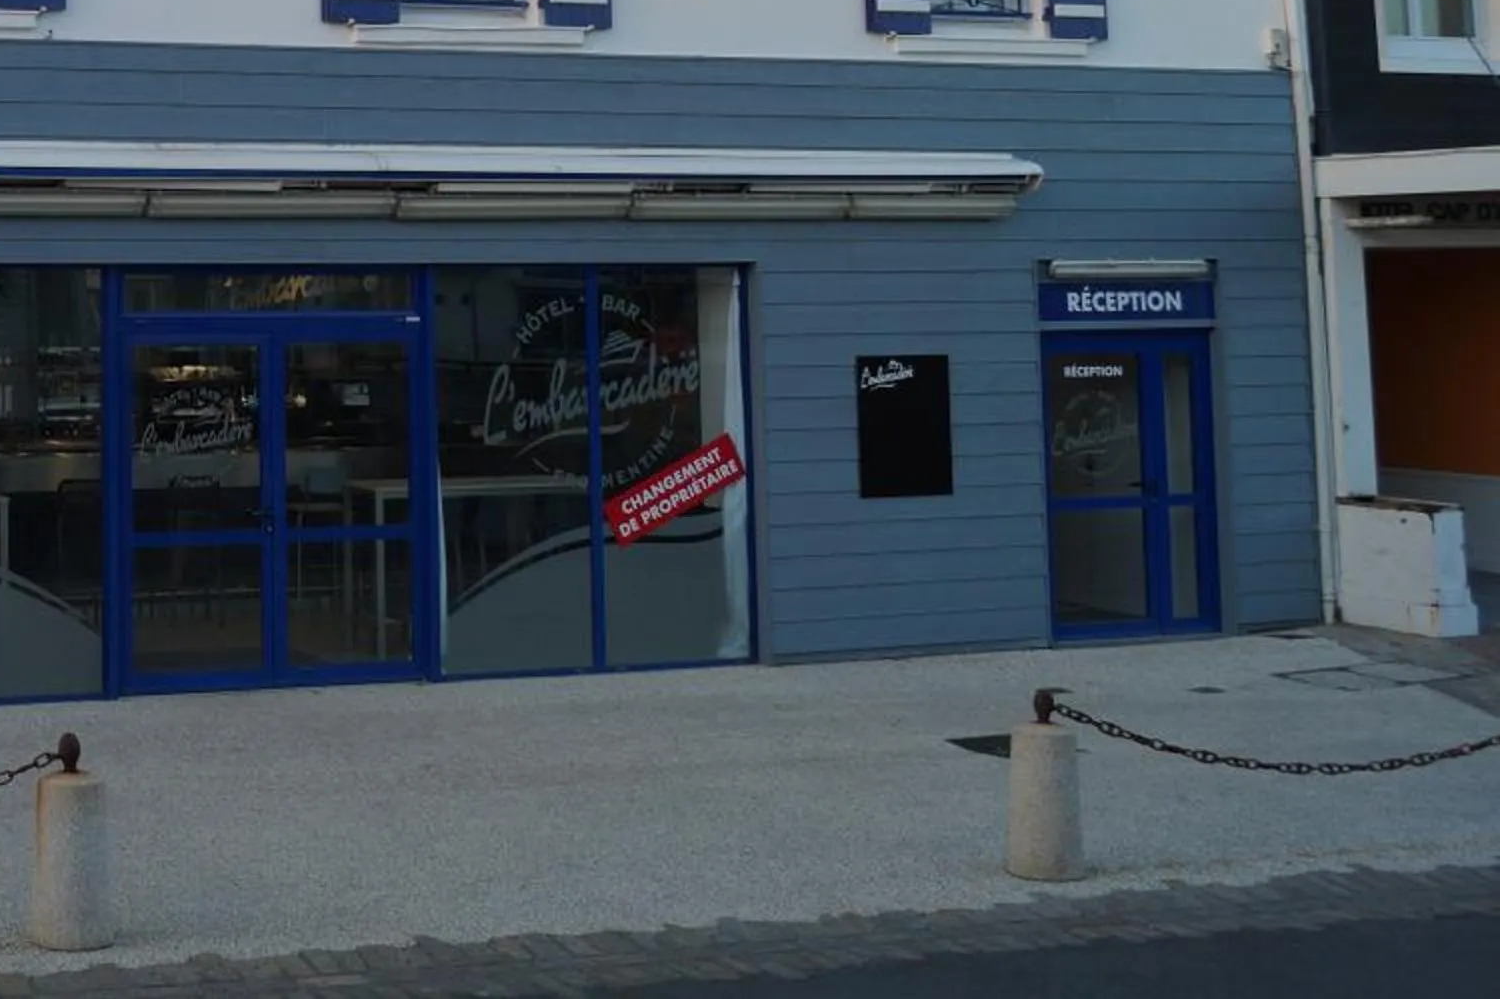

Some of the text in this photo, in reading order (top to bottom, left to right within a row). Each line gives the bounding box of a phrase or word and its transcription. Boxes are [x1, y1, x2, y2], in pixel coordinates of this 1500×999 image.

[516, 294, 640, 345] HÔTEL BAR
[1067, 285, 1183, 312] RÉCEPTION
[1063, 362, 1124, 378] RÉCEPTION
[619, 459, 739, 537] DE PROPRIÉTAIRE
[621, 446, 722, 514] CHANGEMENT
